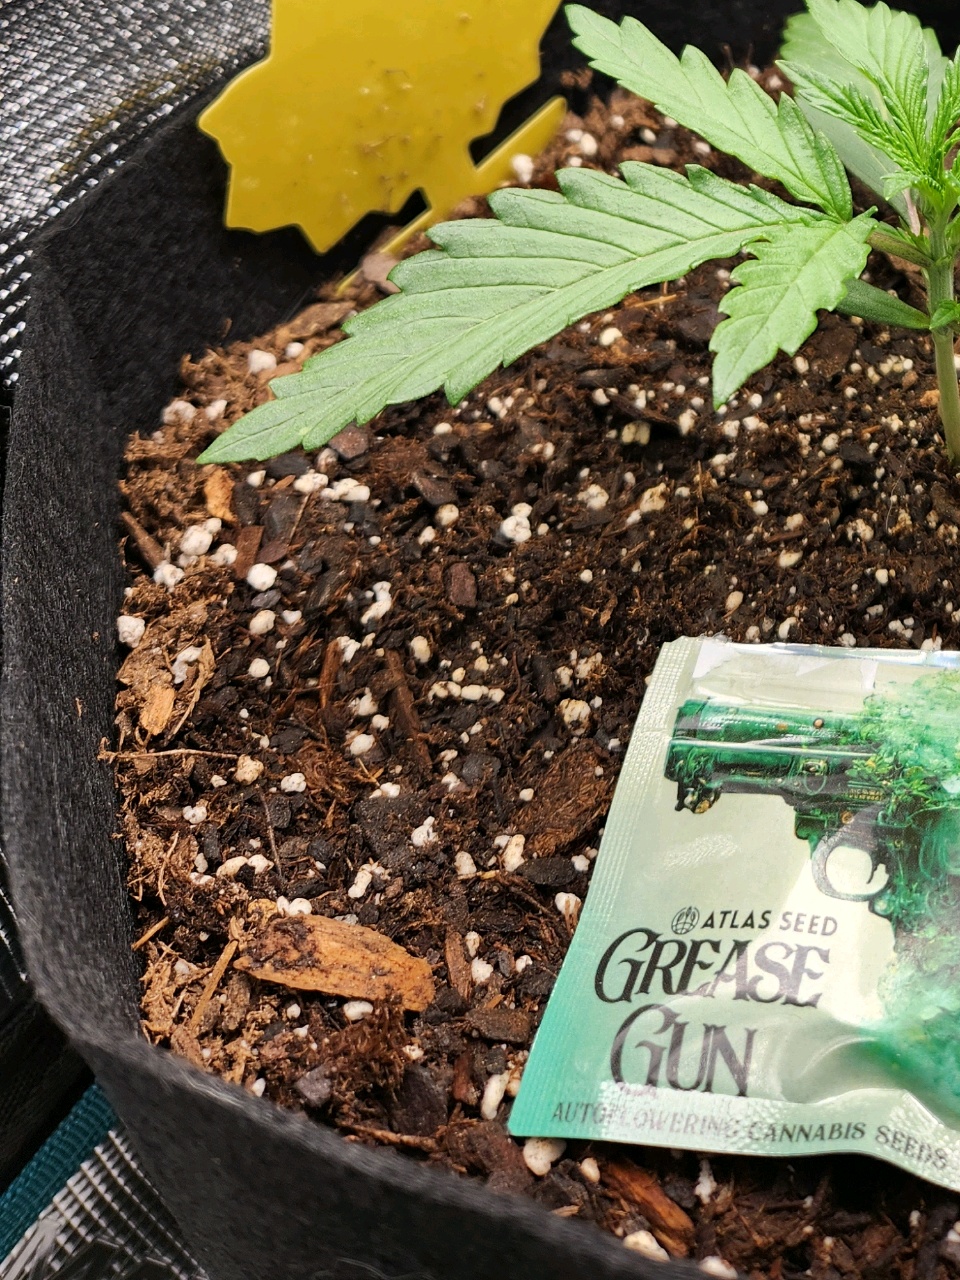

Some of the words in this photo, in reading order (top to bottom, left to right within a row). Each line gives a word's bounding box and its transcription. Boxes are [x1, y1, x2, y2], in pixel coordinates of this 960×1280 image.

[700, 909, 773, 930] ATLAS
[778, 910, 838, 937] SEED
[594, 927, 831, 1009] GREASE
[609, 1003, 758, 1098] GUN
[749, 1121, 867, 1144] CANNABIS
[875, 1125, 950, 1170] SEEDS
